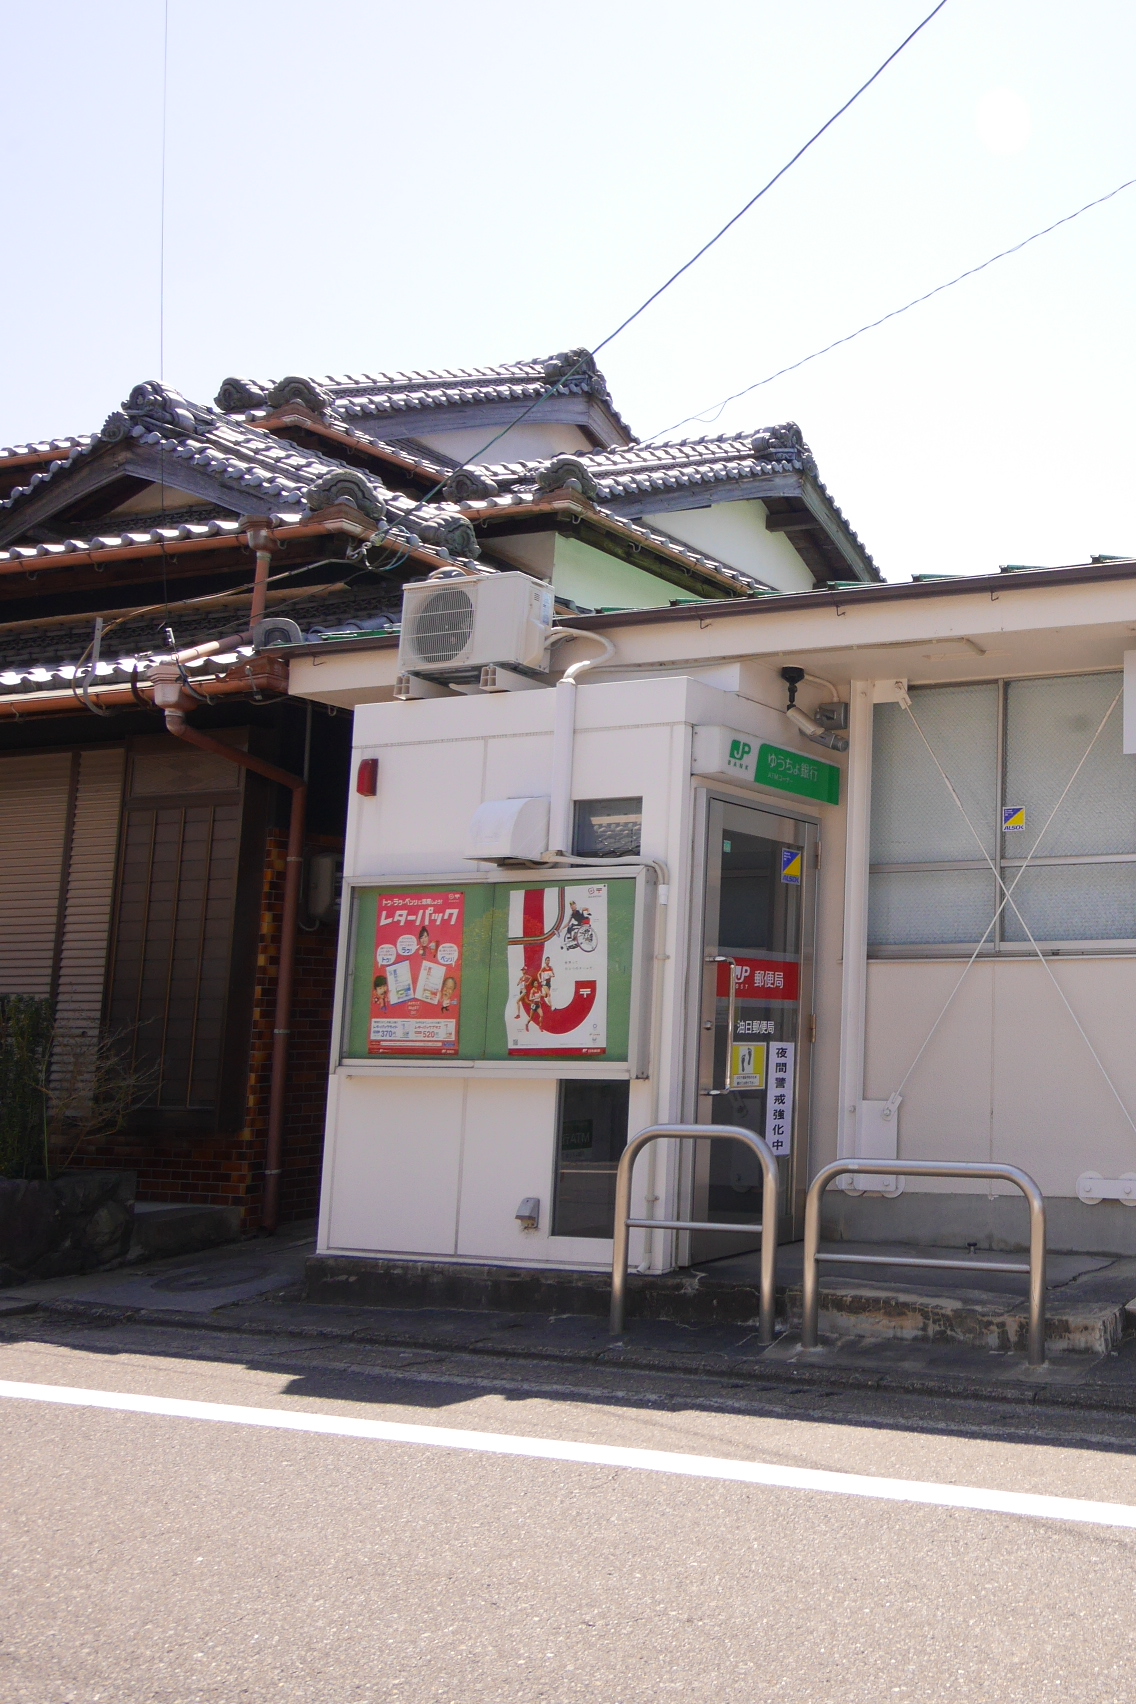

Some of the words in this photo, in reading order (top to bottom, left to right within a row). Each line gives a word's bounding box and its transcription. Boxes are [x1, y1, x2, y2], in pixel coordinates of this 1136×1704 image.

[727, 759, 749, 771] BANK
[767, 753, 818, 781] ゆうちょ銀行
[380, 906, 459, 926] レターパック
[754, 970, 784, 989] 郵便局
[736, 1020, 775, 1034] 油日郵便局
[772, 1047, 789, 1151] 夜間警戒強化中
